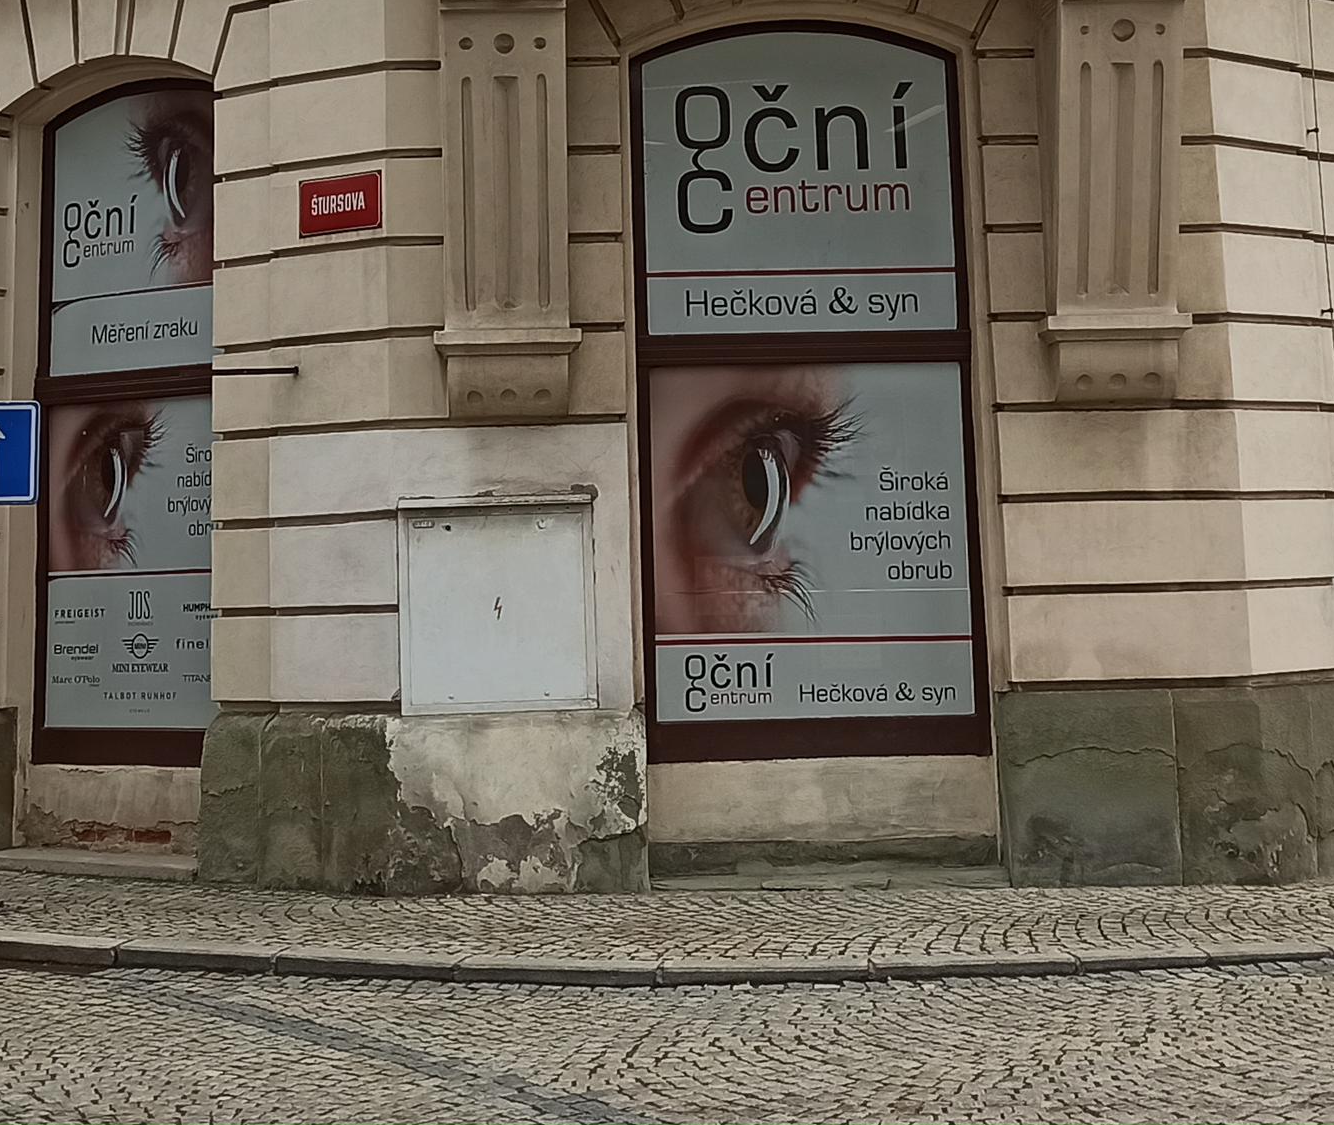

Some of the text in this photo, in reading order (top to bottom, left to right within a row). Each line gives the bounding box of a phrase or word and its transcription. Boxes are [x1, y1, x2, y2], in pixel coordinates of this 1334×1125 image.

[674, 81, 913, 174] Oční
[311, 190, 366, 216] ŠTURSOVA
[677, 169, 910, 234] Centrum
[64, 194, 138, 240] Oční
[63, 238, 134, 268] Centrum
[685, 286, 919, 321] Hečková & syn
[91, 316, 199, 345] Měření zraku
[186, 442, 212, 464] Širo
[177, 470, 212, 488] nabíd
[879, 466, 948, 491] Široká
[167, 495, 212, 517] brýlový
[865, 500, 950, 521] nabídka
[850, 529, 951, 556] brýlových
[888, 559, 953, 580] obrub
[54, 608, 106, 619] FREIGEIST
[182, 602, 212, 612] HUMPH
[54, 643, 99, 655] Brendel
[175, 638, 210, 650] finel
[112, 662, 169, 673] MINI EYEWEAR
[181, 674, 212, 683] TITAN
[684, 653, 775, 688] Oční
[51, 675, 72, 684] Marc
[104, 691, 177, 700] TALBOT RUNHOF
[685, 687, 772, 713] Centrum
[799, 682, 957, 707] Hečková & syn
